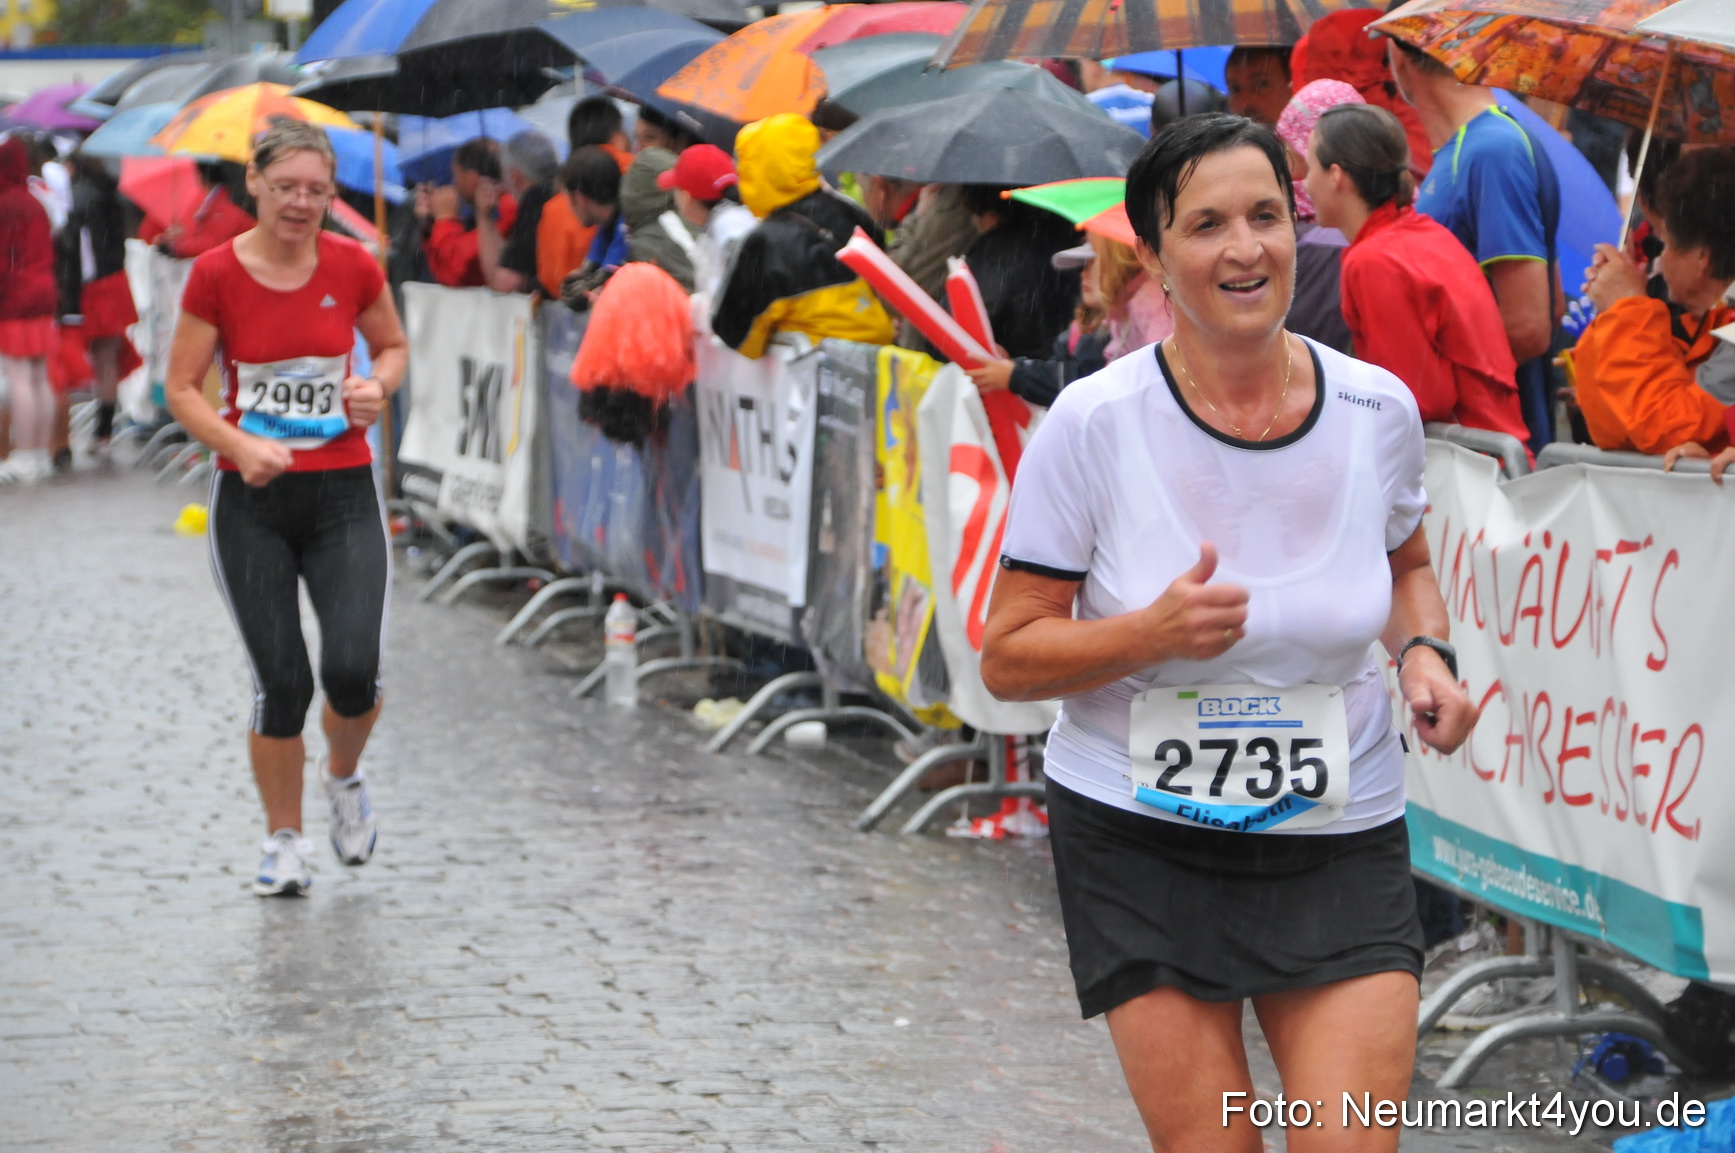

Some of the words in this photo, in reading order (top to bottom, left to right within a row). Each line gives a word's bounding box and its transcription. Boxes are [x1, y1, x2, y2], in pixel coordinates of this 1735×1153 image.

[250, 382, 335, 416] 2993
[1338, 391, 1382, 411] skinfit
[1198, 696, 1282, 716] BOCK
[1154, 736, 1329, 800] 2735
